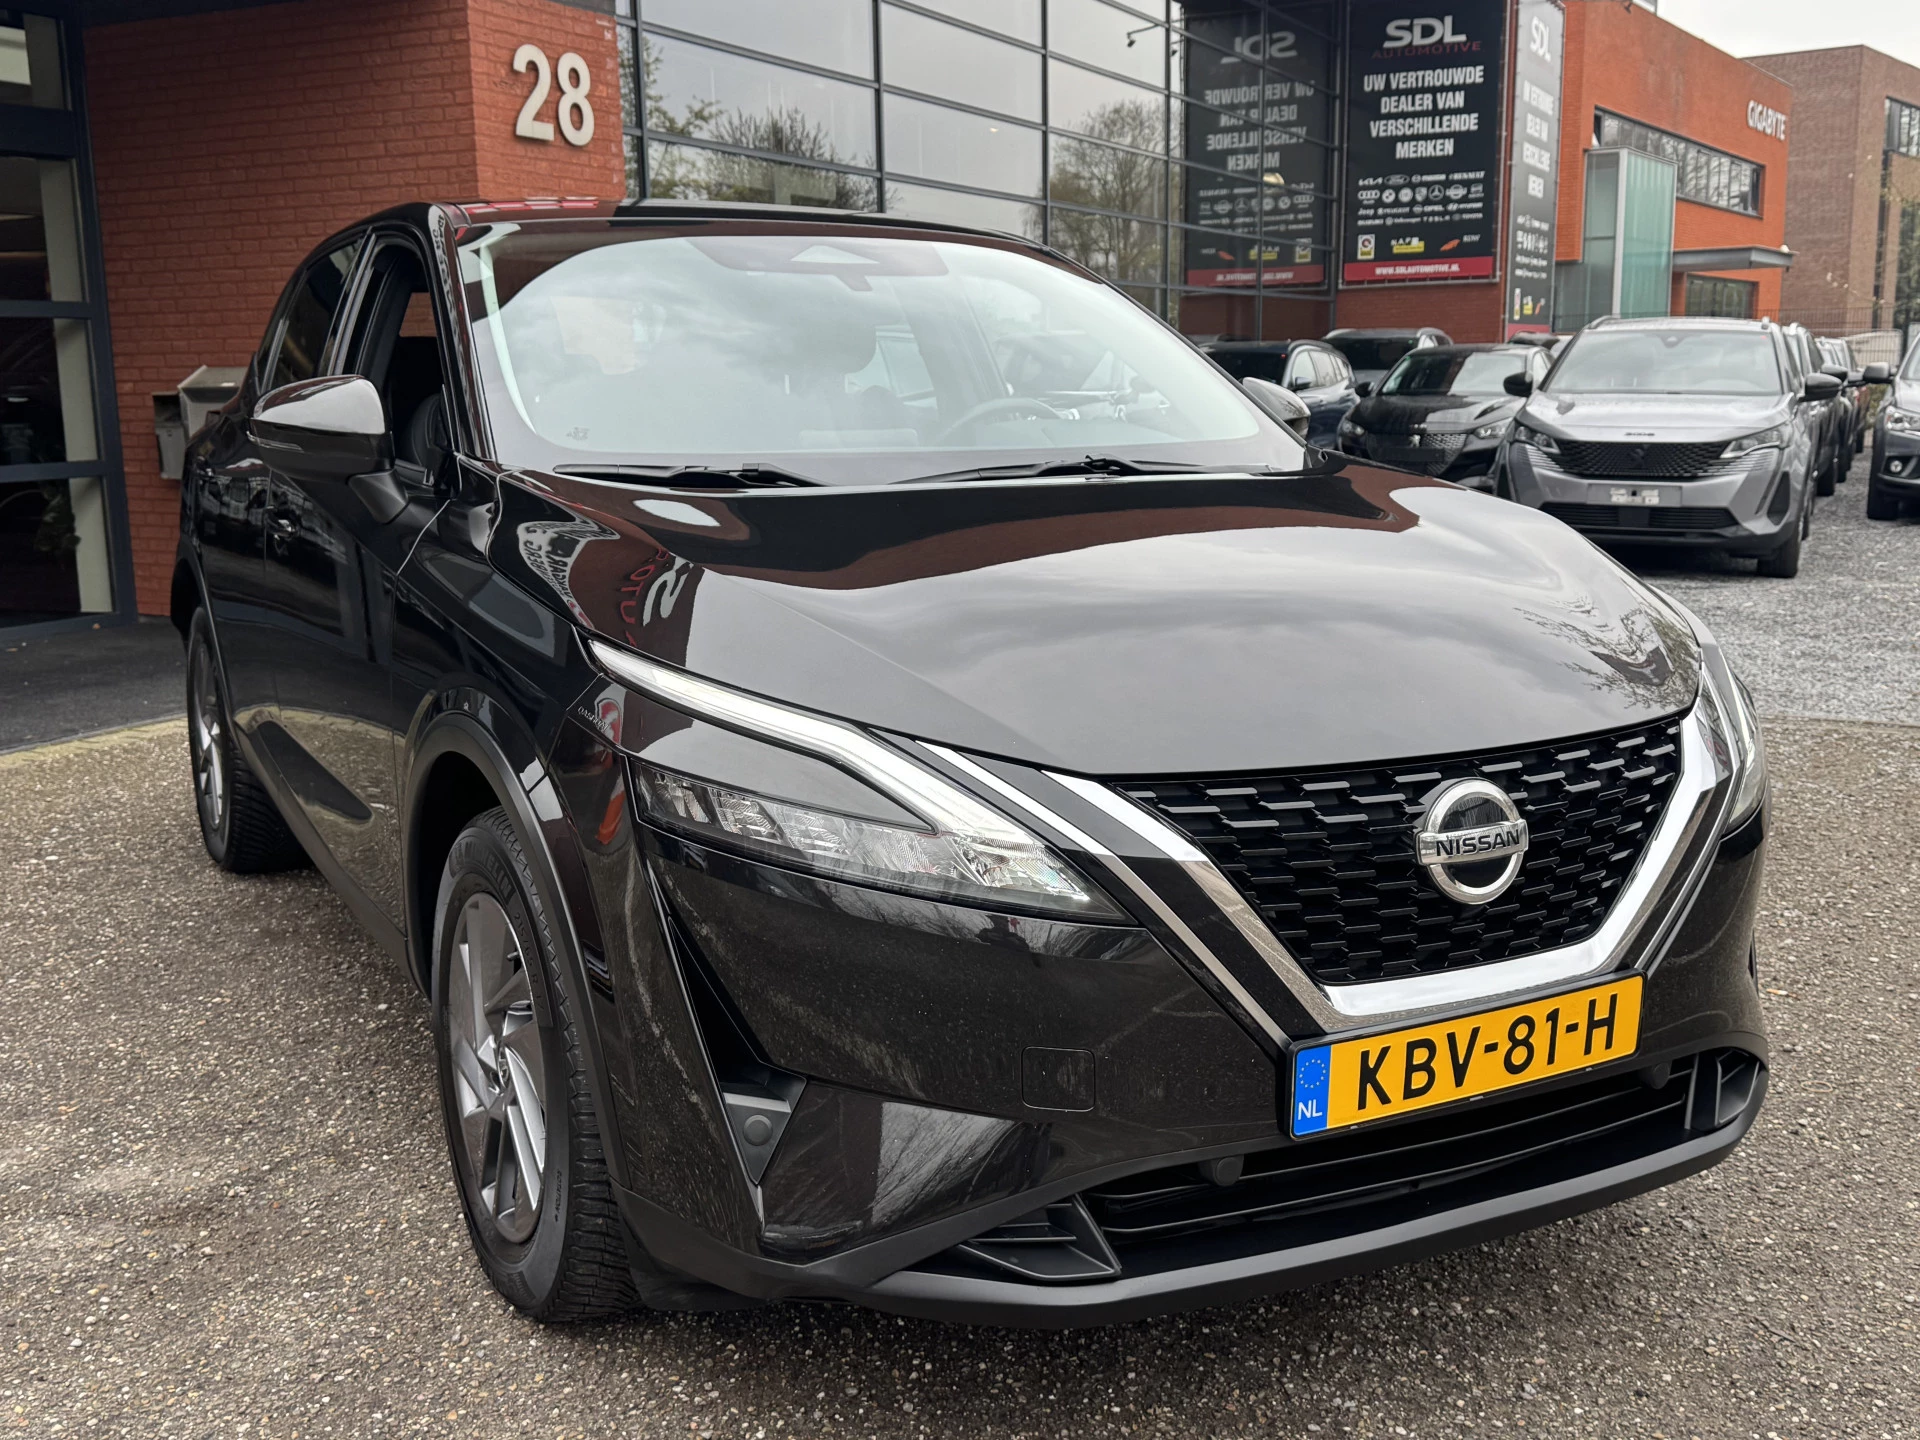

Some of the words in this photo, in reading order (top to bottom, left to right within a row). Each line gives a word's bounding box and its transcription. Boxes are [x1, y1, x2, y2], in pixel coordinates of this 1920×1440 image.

[1383, 15, 1467, 48] SDL
[1371, 41, 1482, 59] AUTOMOTIVE
[1364, 74, 1387, 92] UW
[1389, 65, 1485, 90] VERTROUWDE
[513, 44, 595, 146] 28
[1381, 93, 1433, 114] DEALER
[1436, 90, 1465, 110] VAN
[1370, 113, 1479, 138] VERSCHILLENDE
[1395, 138, 1455, 159] MERKEN
[1436, 829, 1520, 857] NISSAN
[1357, 993, 1618, 1111] KBV-81-H
[1297, 1101, 1323, 1121] NL
